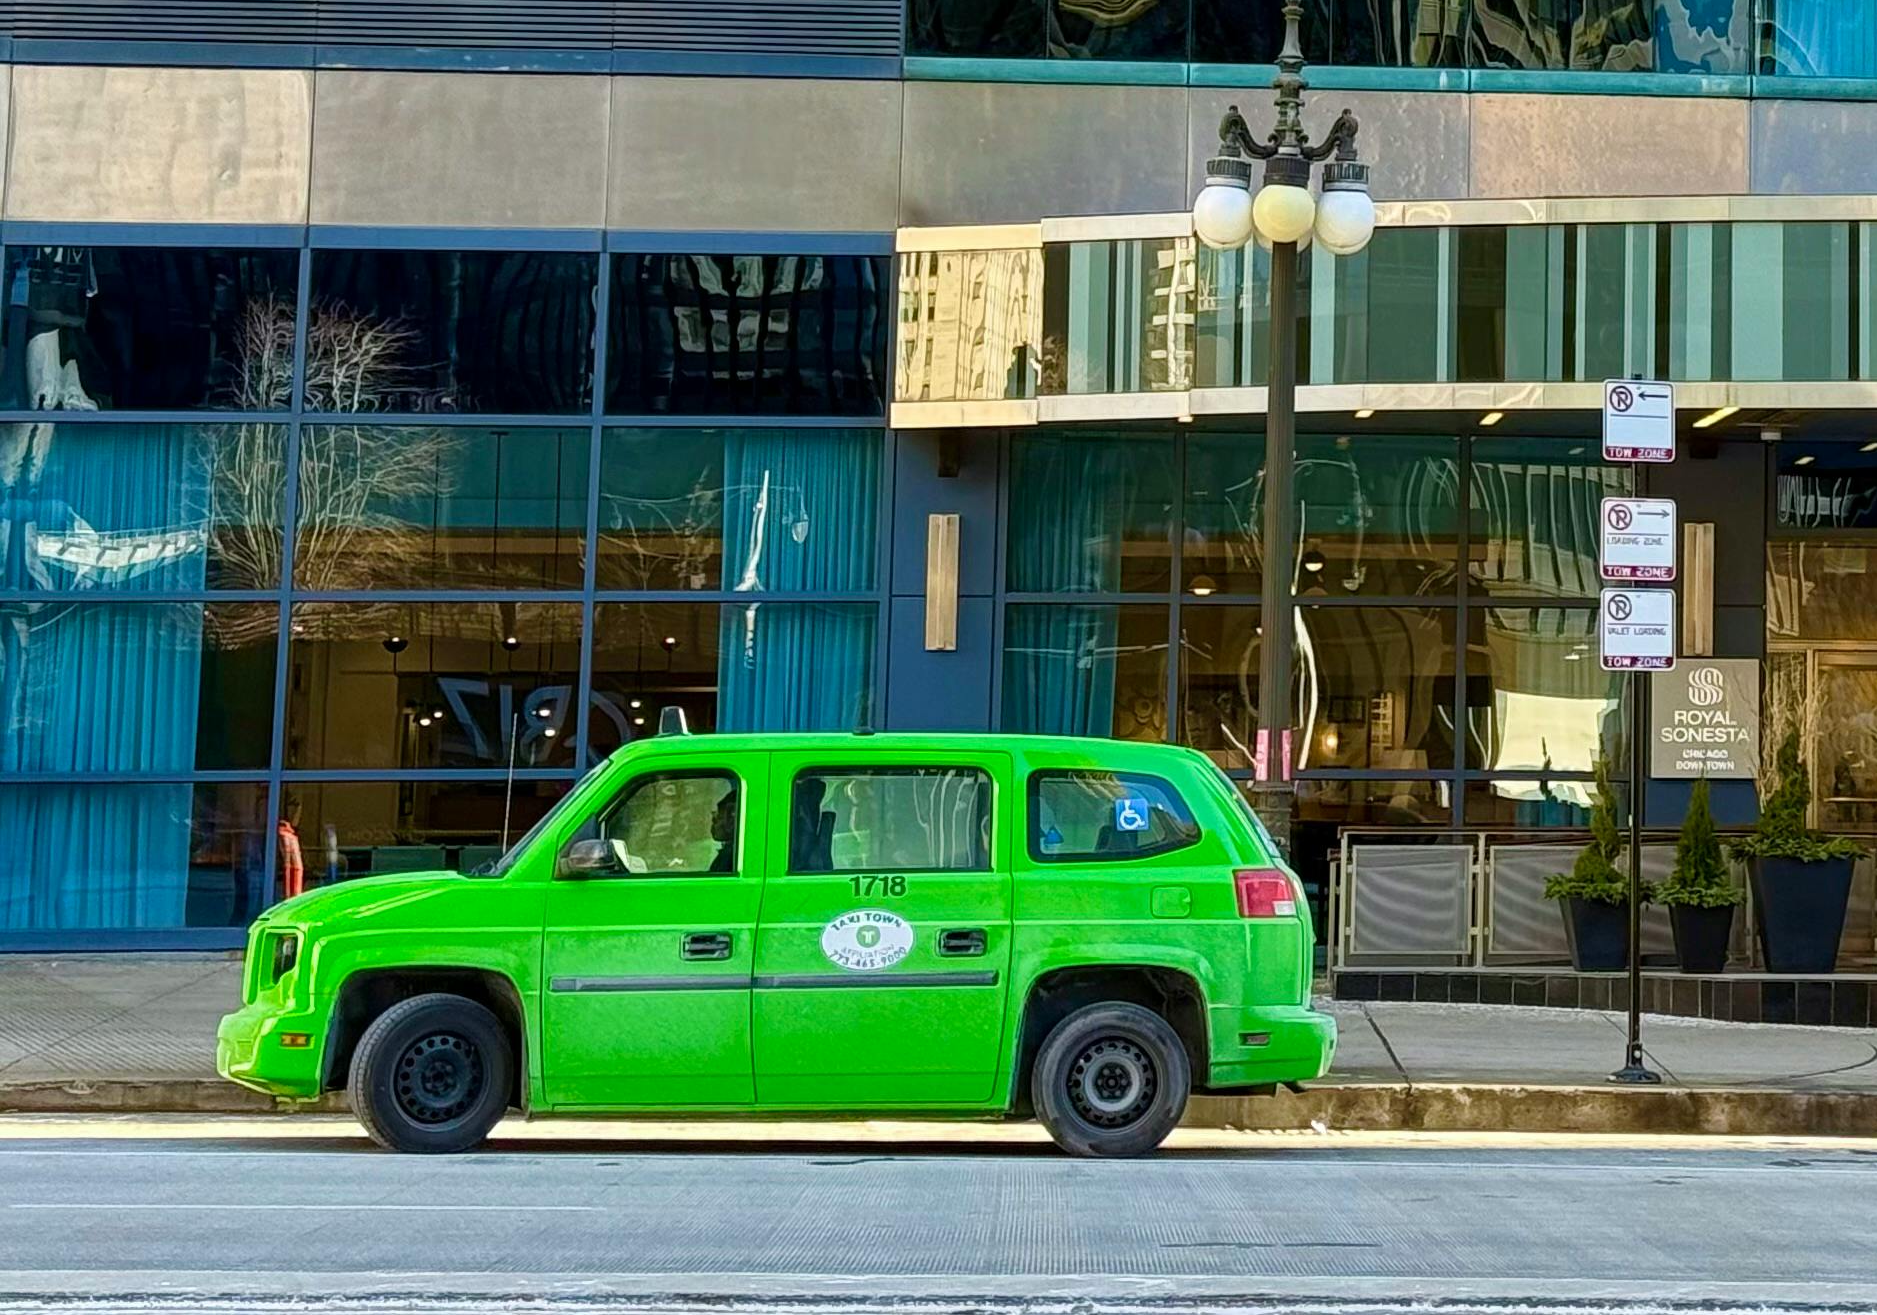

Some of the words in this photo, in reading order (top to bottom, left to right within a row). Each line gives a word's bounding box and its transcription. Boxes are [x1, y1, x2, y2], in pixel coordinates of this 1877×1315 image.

[1608, 448, 1632, 458] TOW
[1637, 448, 1669, 460] ZONE
[1606, 566, 1632, 576] TOW
[1636, 567, 1670, 578] ZONE
[1608, 627, 1630, 636] VALET
[1634, 627, 1667, 636] LOADING
[1606, 657, 1632, 667] TOW
[1636, 657, 1668, 668] ZONE
[1674, 710, 1737, 726] ROYAL
[1660, 727, 1750, 743] SONESTA
[1682, 748, 1729, 759] CHICAGO
[849, 875, 907, 898] 1718
[830, 914, 861, 932] TAXI
[864, 912, 903, 929] TOWN
